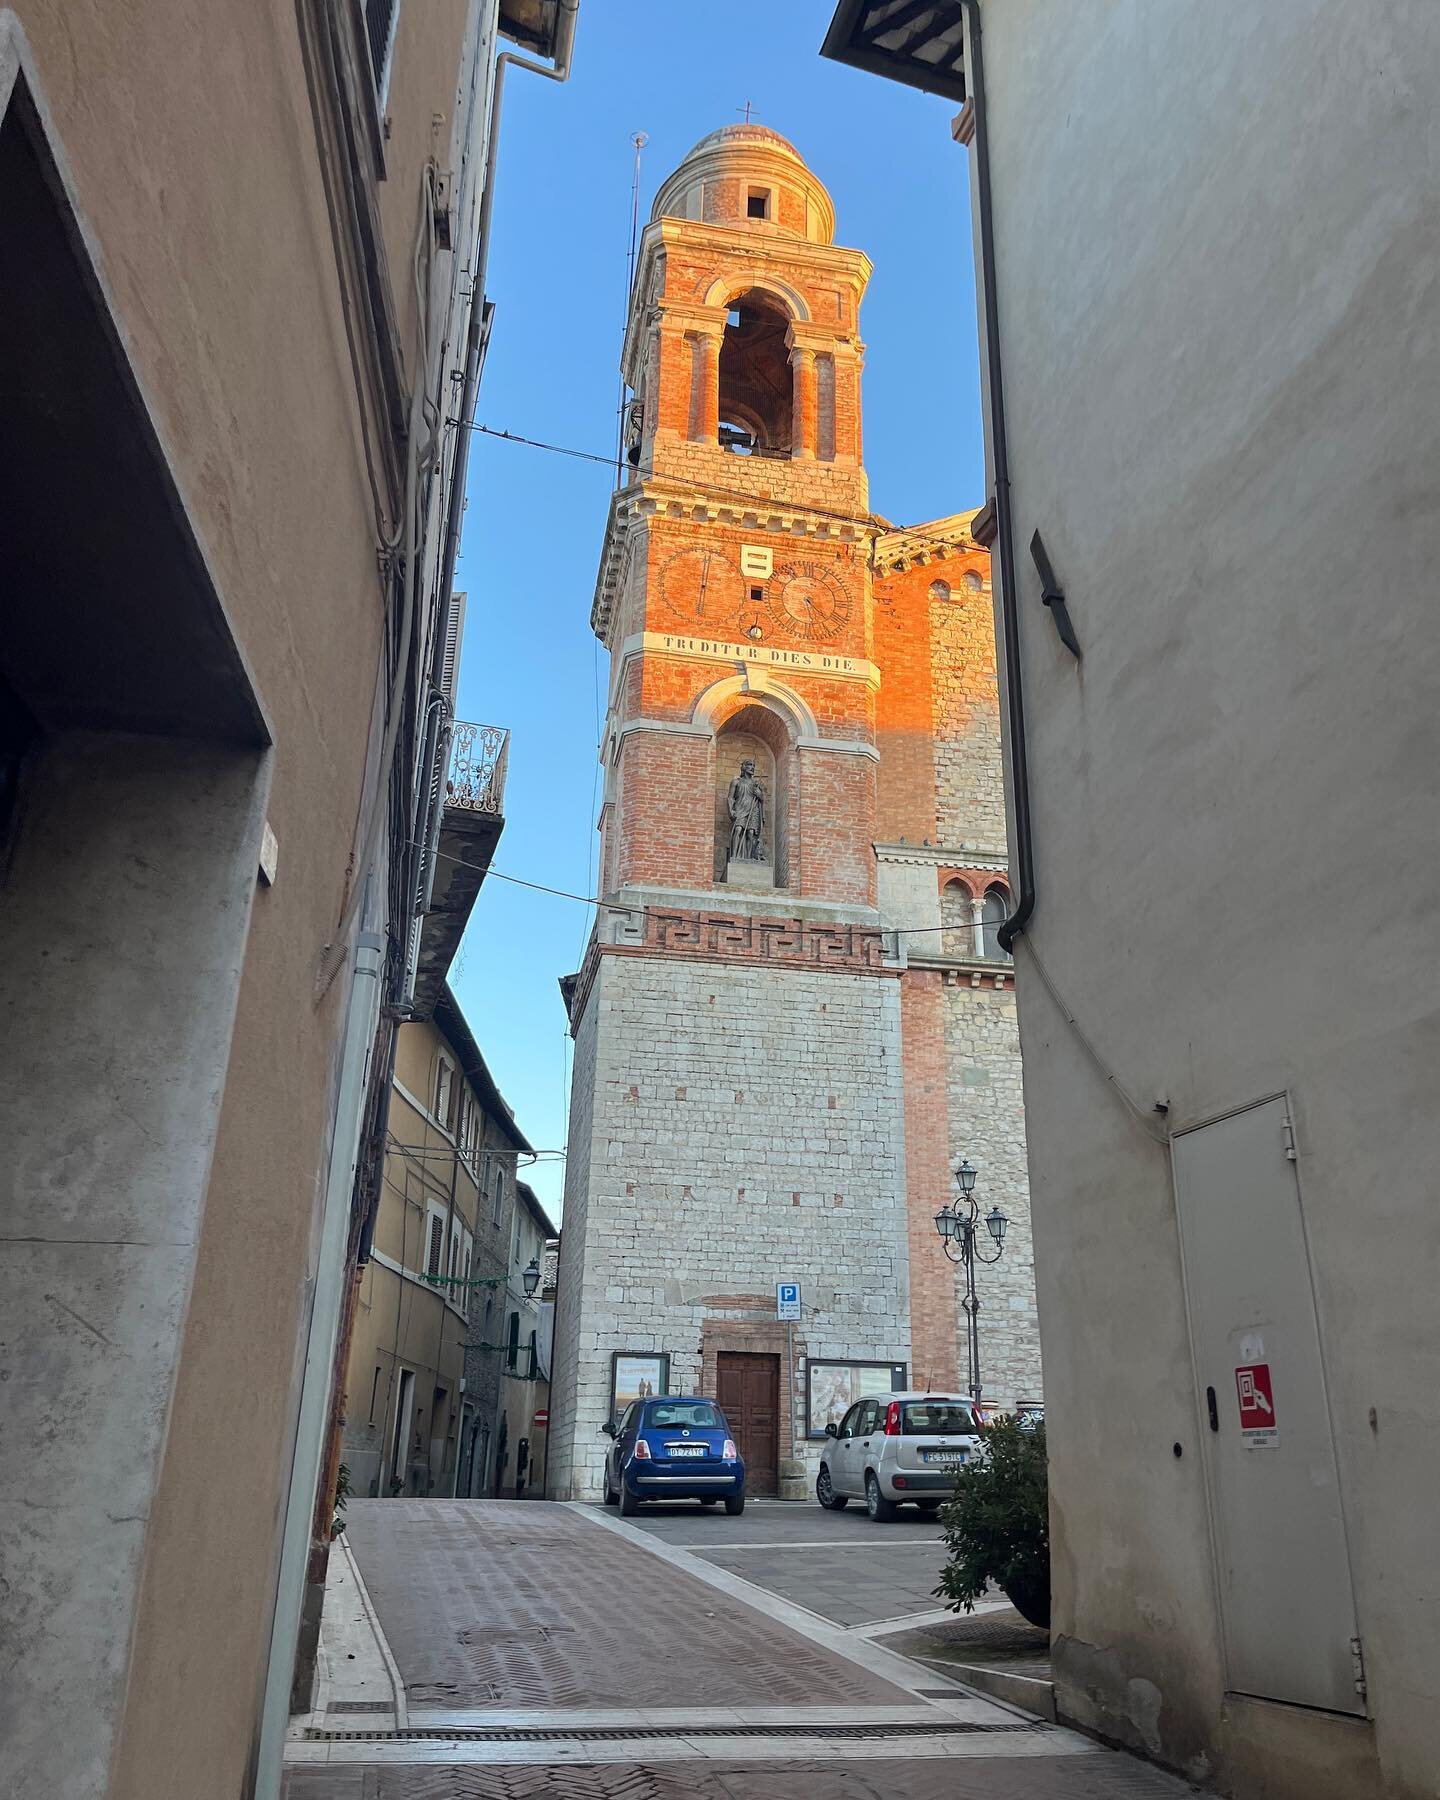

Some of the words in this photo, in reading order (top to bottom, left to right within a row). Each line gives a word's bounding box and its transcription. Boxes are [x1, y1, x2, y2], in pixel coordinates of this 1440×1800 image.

[664, 636, 758, 658] TRUDITUR
[771, 651, 811, 665] DIES
[822, 657, 856, 672] DIE.
[784, 1287, 794, 1300] P
